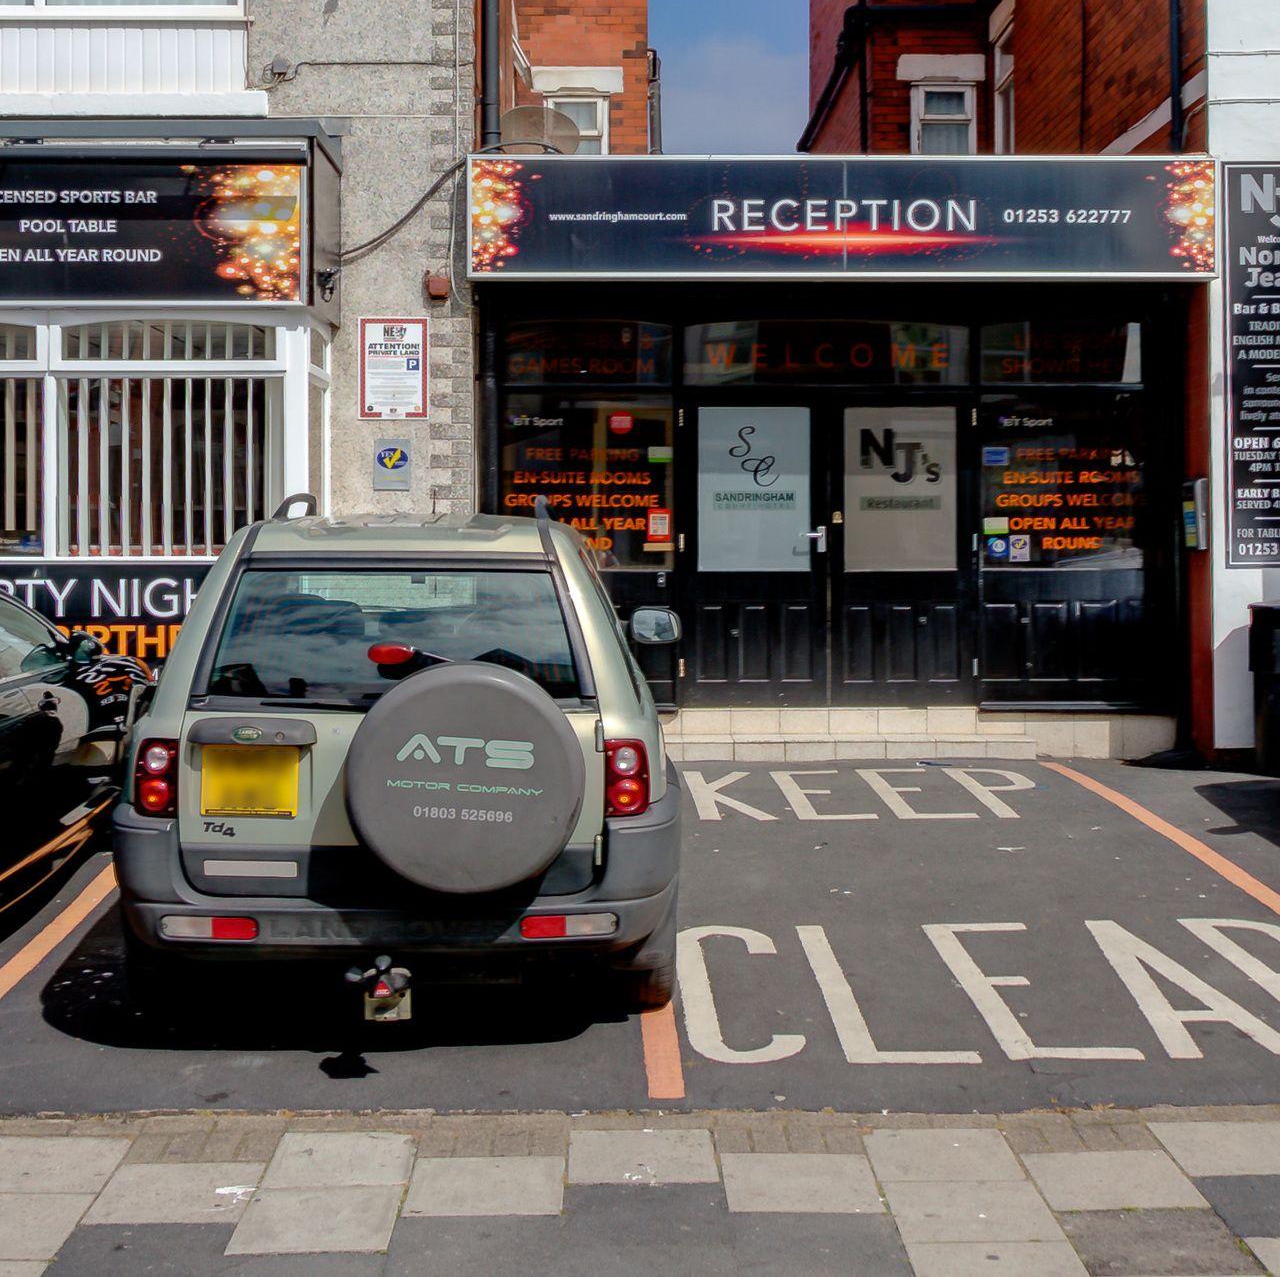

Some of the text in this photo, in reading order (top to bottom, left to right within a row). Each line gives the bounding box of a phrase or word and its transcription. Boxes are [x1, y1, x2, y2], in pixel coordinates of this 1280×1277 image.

[58, 189, 122, 205] SPORTS
[123, 189, 159, 205] BAR
[548, 210, 688, 224] www.sandringhamcourt.com
[710, 199, 978, 233] RECEPTION
[1003, 208, 1133, 224] 01253 622777
[19, 219, 119, 234] POOL TABLE
[23, 248, 57, 263] ALL
[56, 248, 99, 263] YEAR
[102, 248, 163, 264] ROUND
[1233, 302, 1257, 315] Bar
[1259, 302, 1270, 315] &
[1232, 335, 1274, 346] ENGLISH
[705, 340, 951, 370] WELCOME
[1237, 349, 1247, 360] A
[408, 359, 418, 369] P
[508, 355, 656, 375] GAMES ROOM
[531, 416, 565, 428] Sport
[1022, 416, 1054, 428] Sport
[1233, 436, 1270, 449] OPEN
[525, 447, 565, 462] FREE
[859, 427, 943, 485] NJ's
[1015, 447, 1056, 462] FREE
[1233, 450, 1277, 461] TUESDAY
[1248, 462, 1272, 473] 4PM
[513, 471, 652, 485] EN-SUITE ROOMS
[1002, 470, 1141, 485] EN-SUITE ROOMS
[575, 493, 661, 508] WELCOME
[714, 491, 795, 503] SANDRINGHAM
[995, 492, 1150, 508] GROUPS WELCOME
[1236, 488, 1271, 499] EARLY
[866, 497, 934, 510] Restaurant
[1236, 499, 1271, 510] SERVED
[570, 517, 600, 531] ALL
[602, 517, 647, 531] YEAR
[1008, 515, 1137, 531] OPEN ALL YEAR
[1236, 528, 1254, 539] FOR
[1041, 536, 1104, 551] ROUND
[1238, 542, 1279, 556] 01253
[395, 733, 536, 771] ATS
[385, 779, 545, 797] MOTOR COMPANY
[682, 768, 1036, 822] KEEP
[412, 805, 514, 823] 01803 525696
[202, 821, 237, 838] Td4
